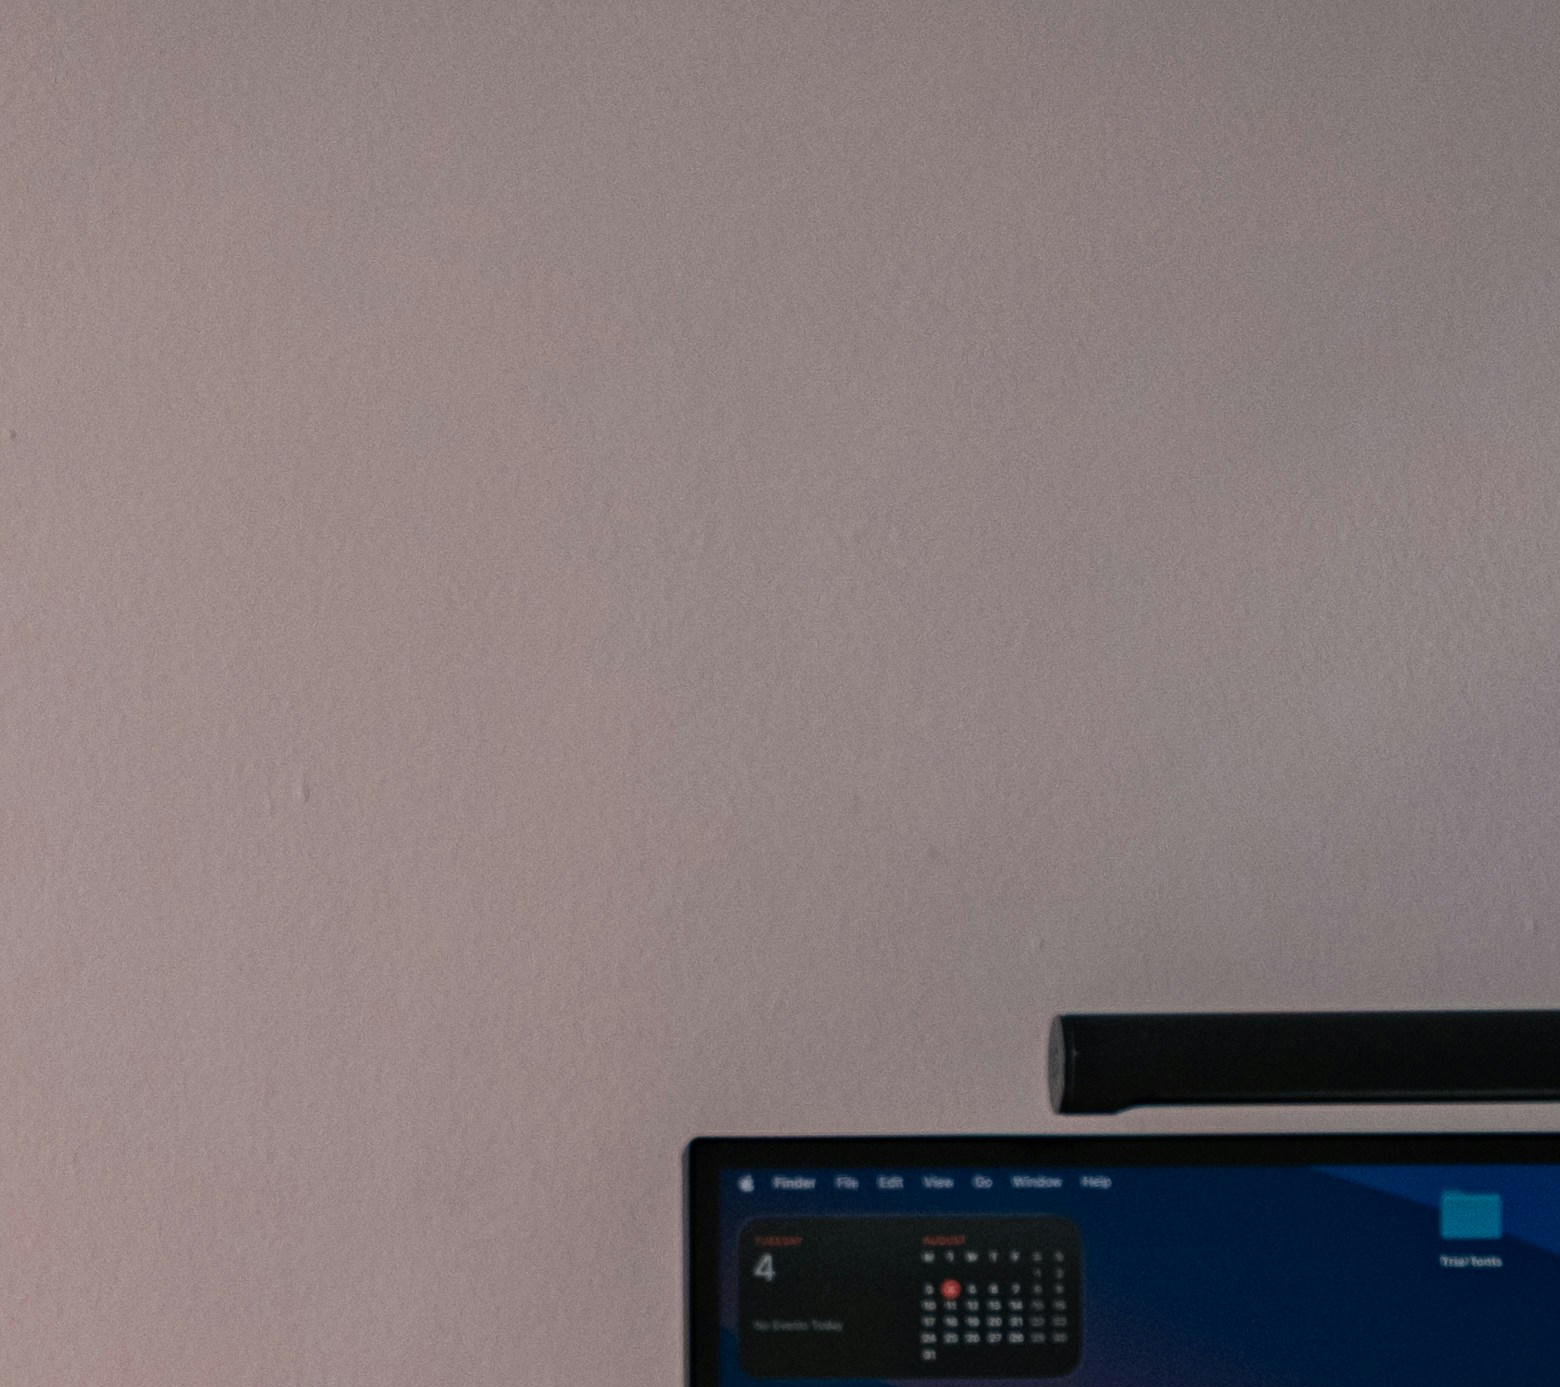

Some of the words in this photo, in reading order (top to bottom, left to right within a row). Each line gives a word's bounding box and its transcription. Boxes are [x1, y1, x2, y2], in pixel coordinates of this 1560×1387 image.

[771, 1174, 817, 1190] Finder
[835, 1174, 859, 1190] File
[878, 1174, 904, 1190] Edit
[922, 1174, 955, 1189] View
[973, 1174, 994, 1190] Go
[1011, 1174, 1063, 1189] Window
[1082, 1174, 1113, 1191] Help
[753, 1252, 776, 1281] 4
